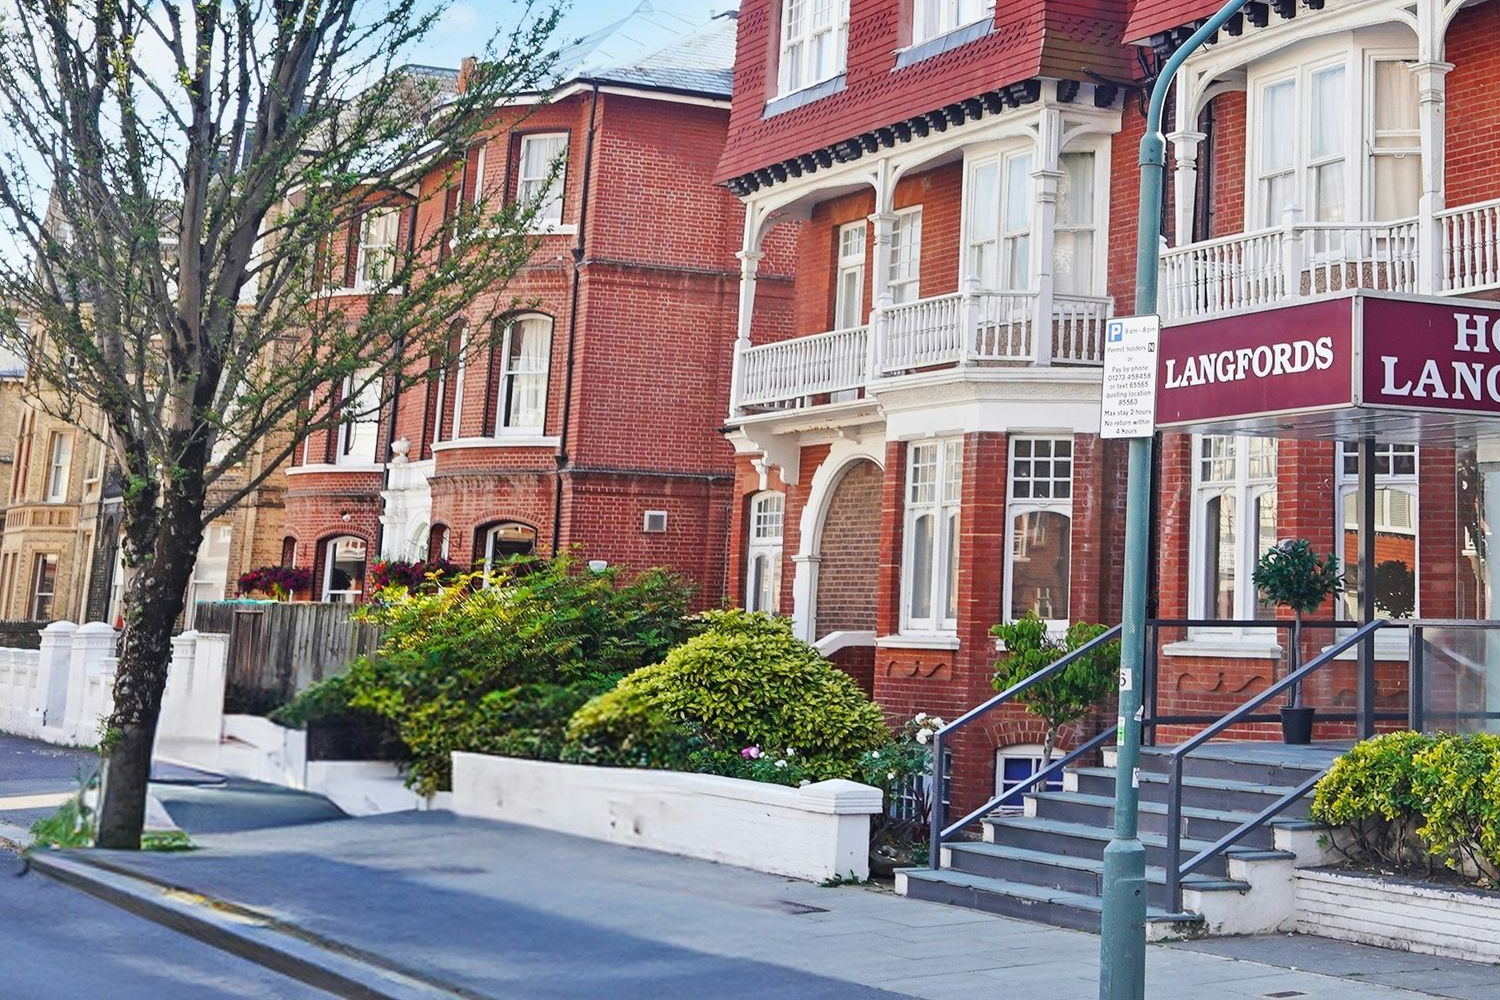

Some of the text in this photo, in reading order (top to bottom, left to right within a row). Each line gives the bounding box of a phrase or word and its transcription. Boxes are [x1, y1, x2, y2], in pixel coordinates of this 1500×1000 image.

[1111, 323, 1122, 342] P
[1126, 344, 1146, 352] holders
[1164, 336, 1334, 389] LANGFORDS
[1131, 364, 1148, 373] phone
[1128, 390, 1151, 398] location
[1133, 418, 1151, 426] within
